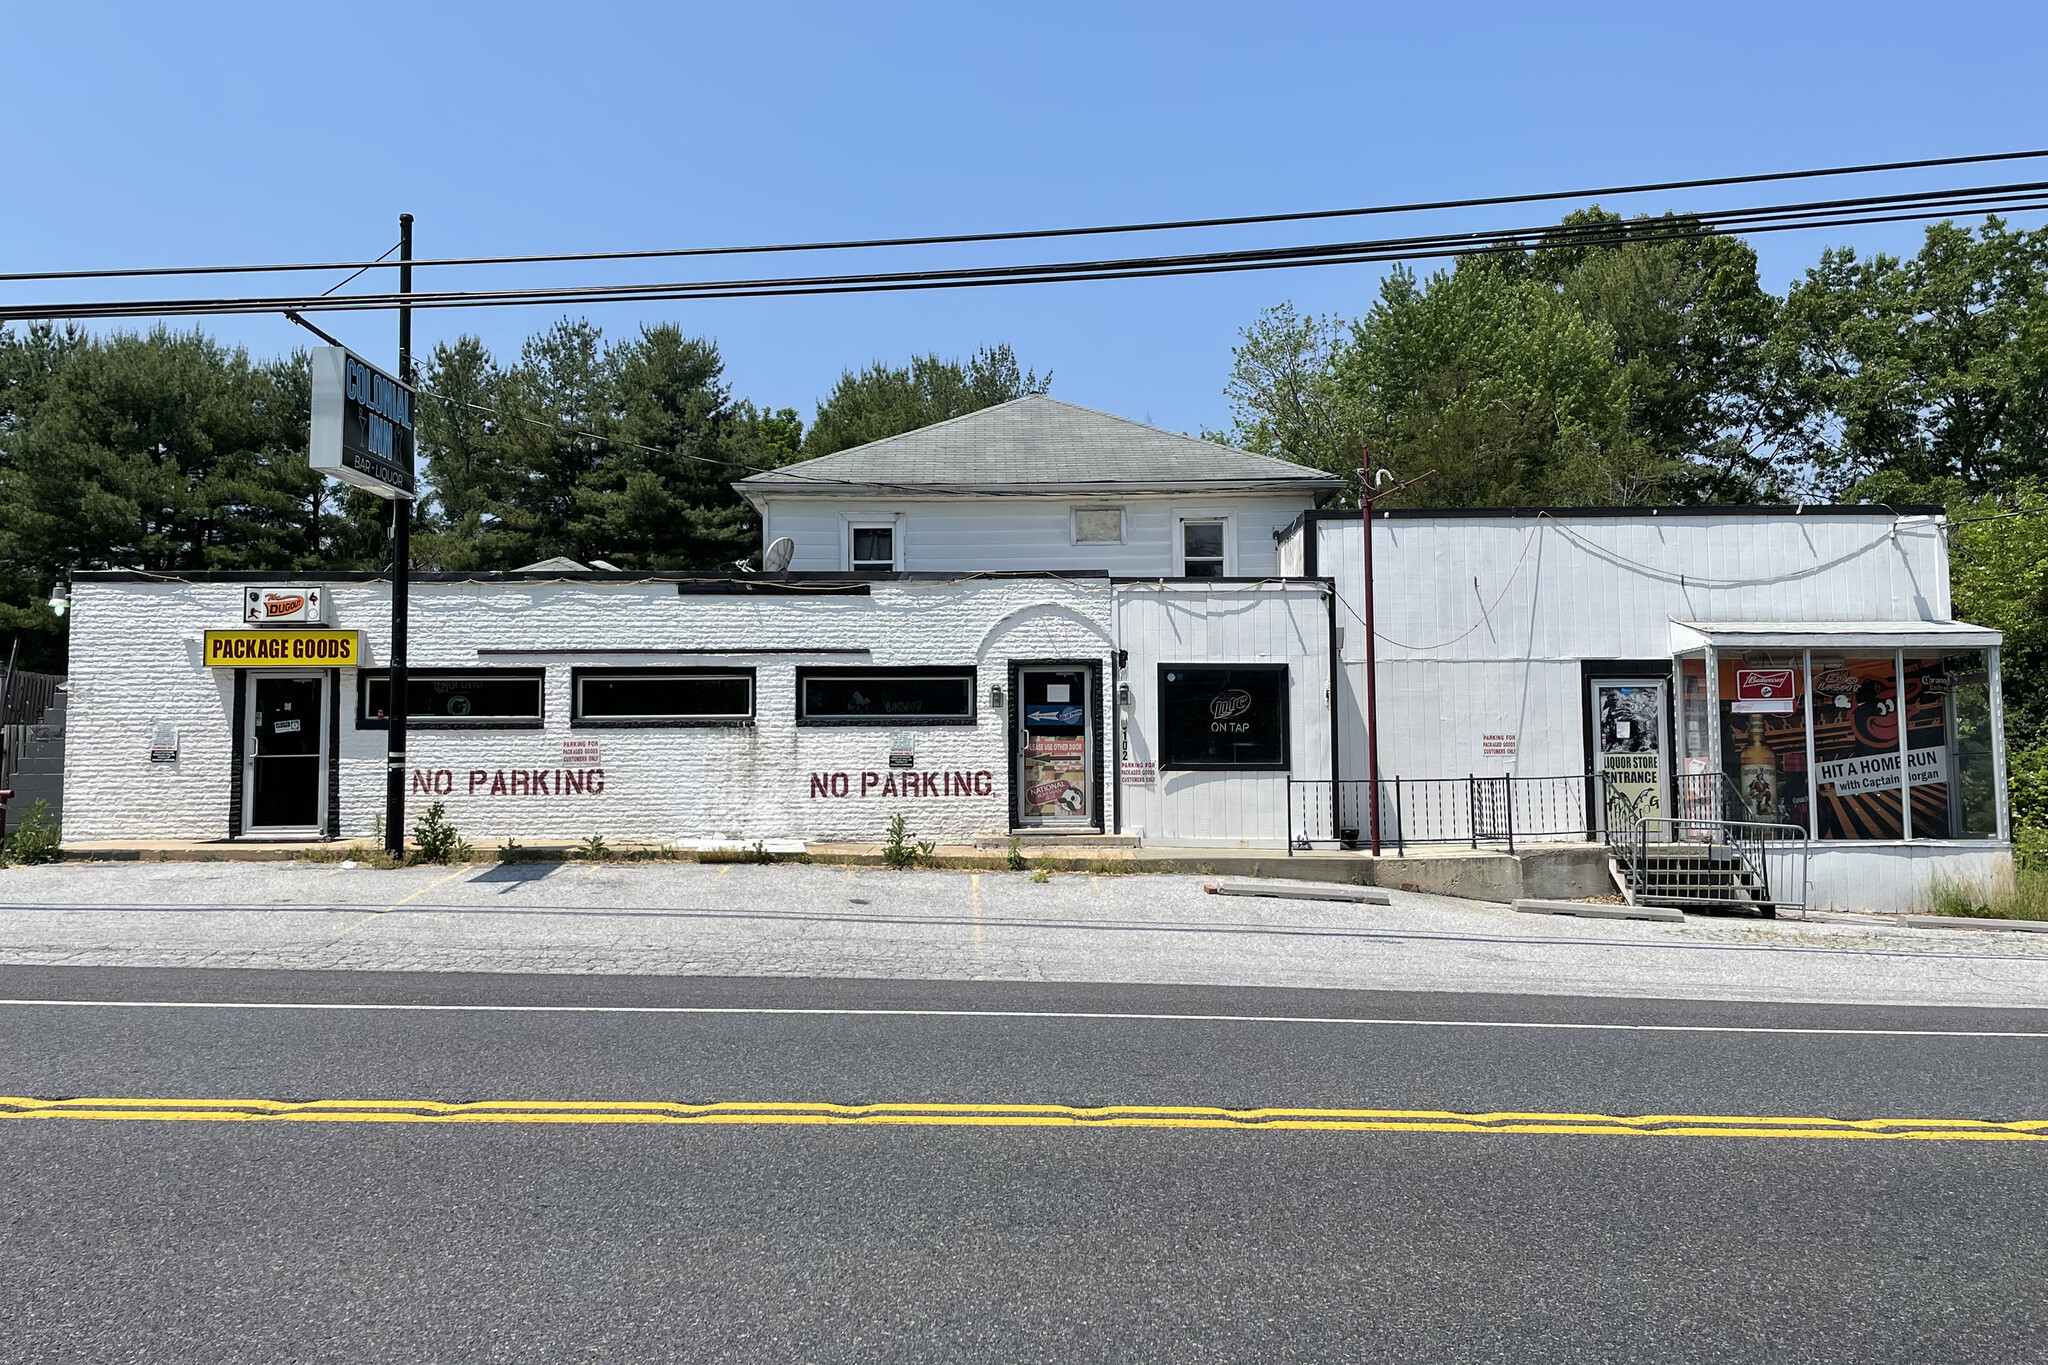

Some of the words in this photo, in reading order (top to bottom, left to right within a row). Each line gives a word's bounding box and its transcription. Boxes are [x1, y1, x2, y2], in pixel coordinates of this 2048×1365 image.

[346, 358, 412, 431] COLONIAL
[368, 412, 393, 461] INN
[354, 454, 371, 473] BAR
[375, 464, 404, 488] LIQUOR
[269, 600, 301, 614] DUGOUT
[212, 639, 289, 659] PACKAGE
[292, 638, 350, 659] GOODS
[1747, 675, 1785, 684] Budweiser
[1210, 722, 1227, 732] ON
[1229, 722, 1250, 732] TAP
[1604, 756, 1632, 770] LIQUOR
[1633, 756, 1658, 769] STORE
[1821, 763, 1844, 779] HIT
[1847, 762, 1858, 776] A
[1860, 756, 1901, 774] HOME
[1907, 751, 1938, 768] RUN
[412, 769, 453, 796] NO
[468, 768, 605, 796] PARKING
[810, 772, 849, 799] NO
[1030, 781, 1066, 795] NATIONAL
[1605, 771, 1658, 784] ENTRANCE
[1839, 780, 1860, 791] with
[1862, 774, 1900, 788] Captain
[1908, 770, 1939, 782] organ
